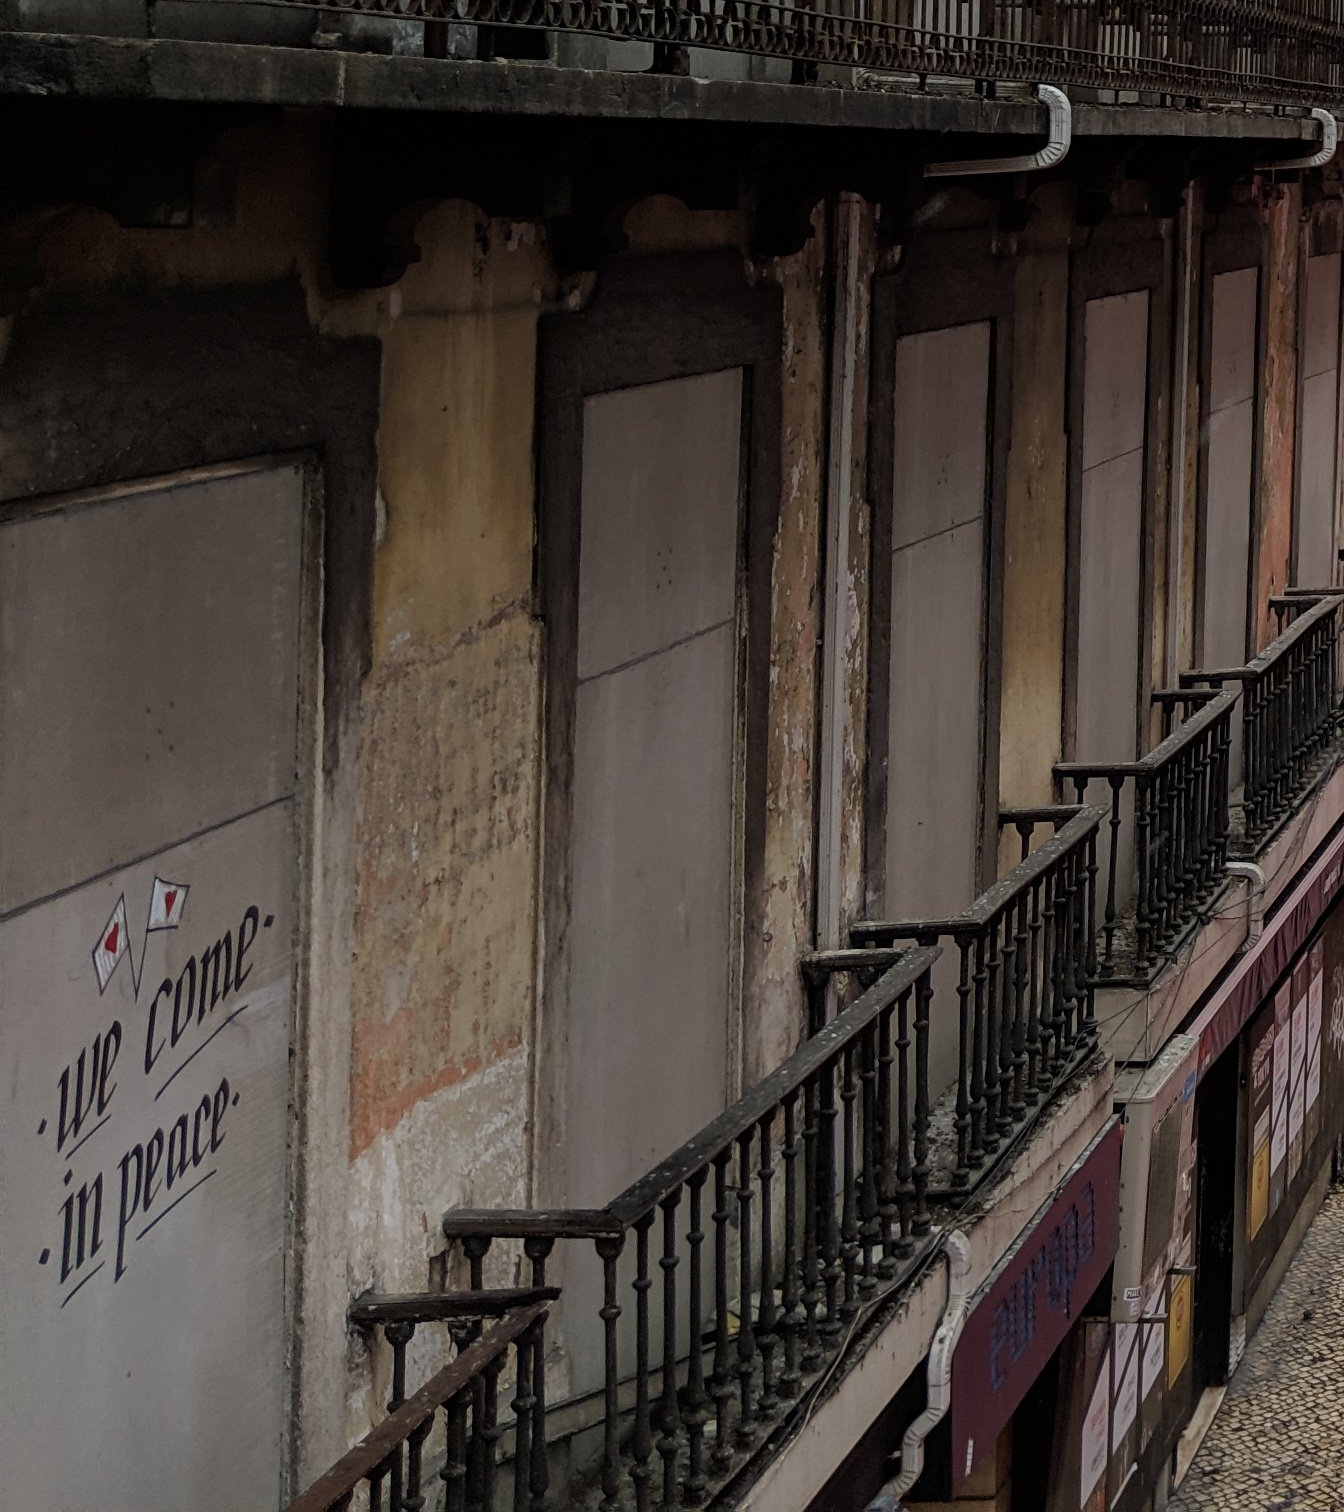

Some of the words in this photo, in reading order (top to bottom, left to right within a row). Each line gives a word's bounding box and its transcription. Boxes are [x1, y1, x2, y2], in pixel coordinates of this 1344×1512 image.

[54, 1018, 123, 1154] we
[143, 904, 261, 1076] come
[58, 1167, 106, 1287] in
[113, 1075, 232, 1284] peace
